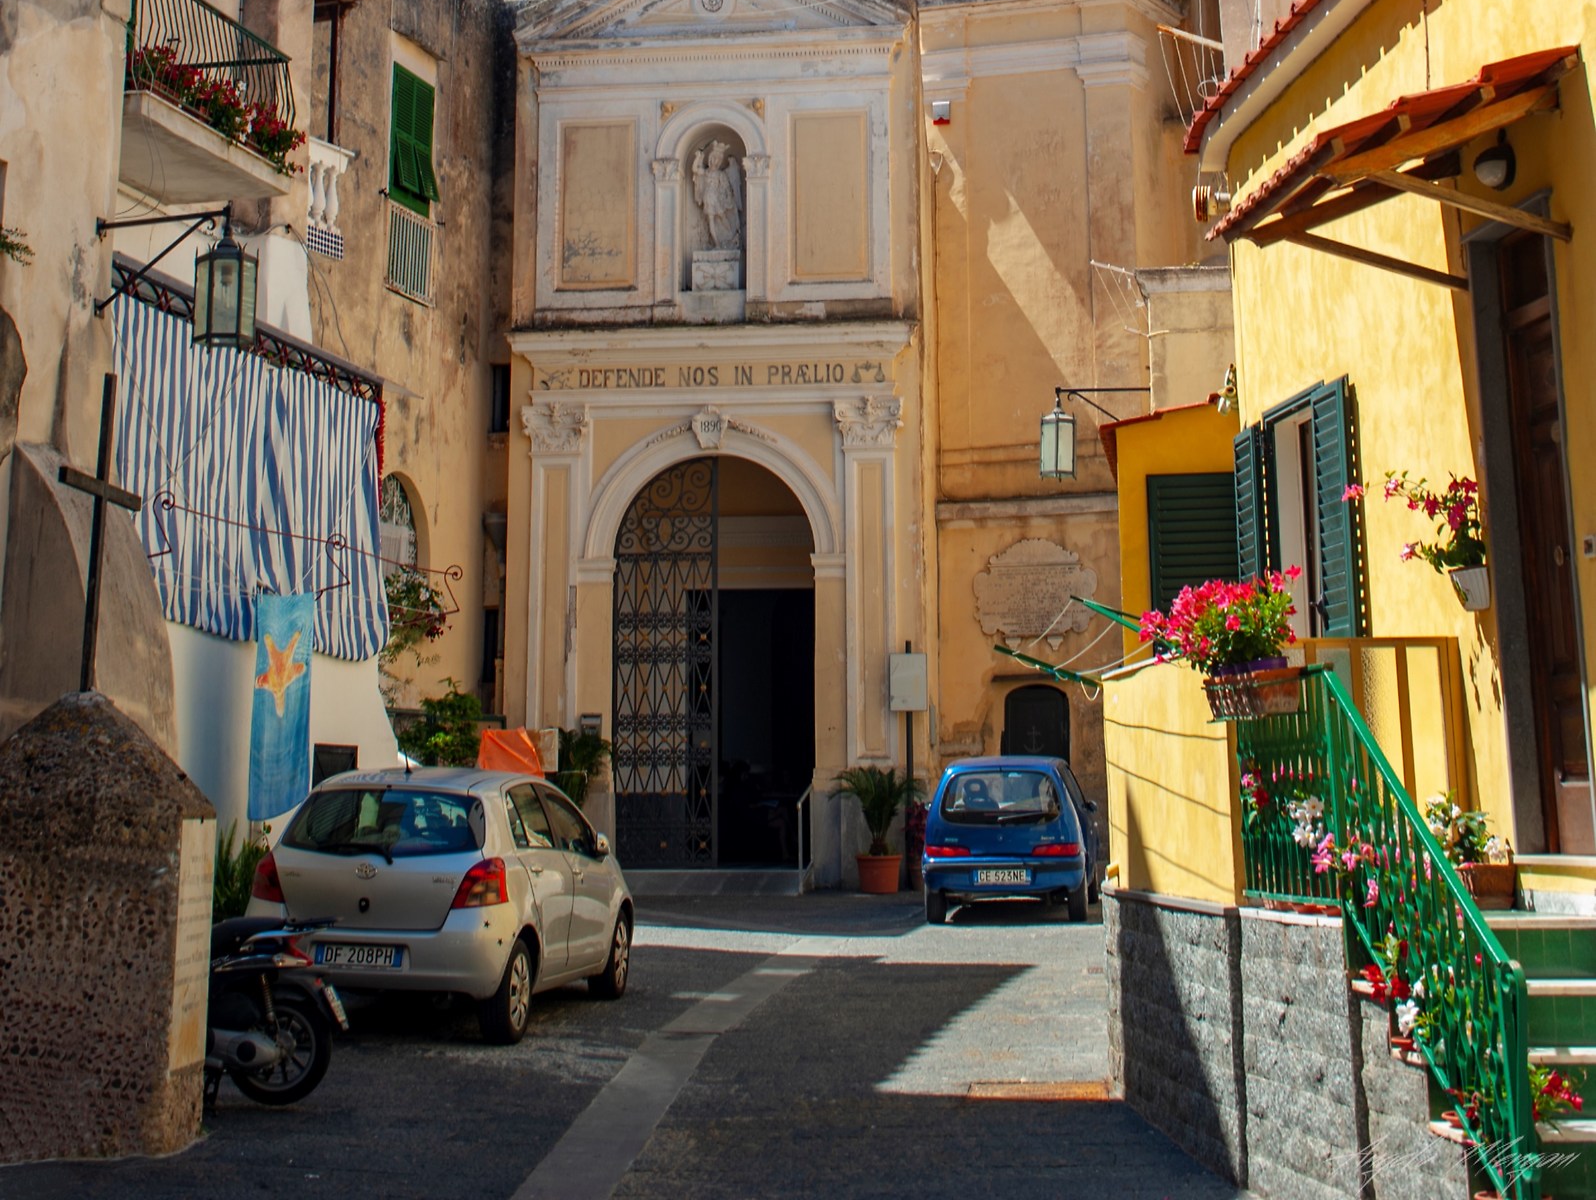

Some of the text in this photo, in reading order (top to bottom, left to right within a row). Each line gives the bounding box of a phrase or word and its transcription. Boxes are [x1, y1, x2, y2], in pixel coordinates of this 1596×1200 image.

[579, 367, 666, 388] DEFENDE
[679, 366, 719, 387] NOS
[734, 365, 752, 386] IN
[324, 946, 394, 964] DF 208PH
